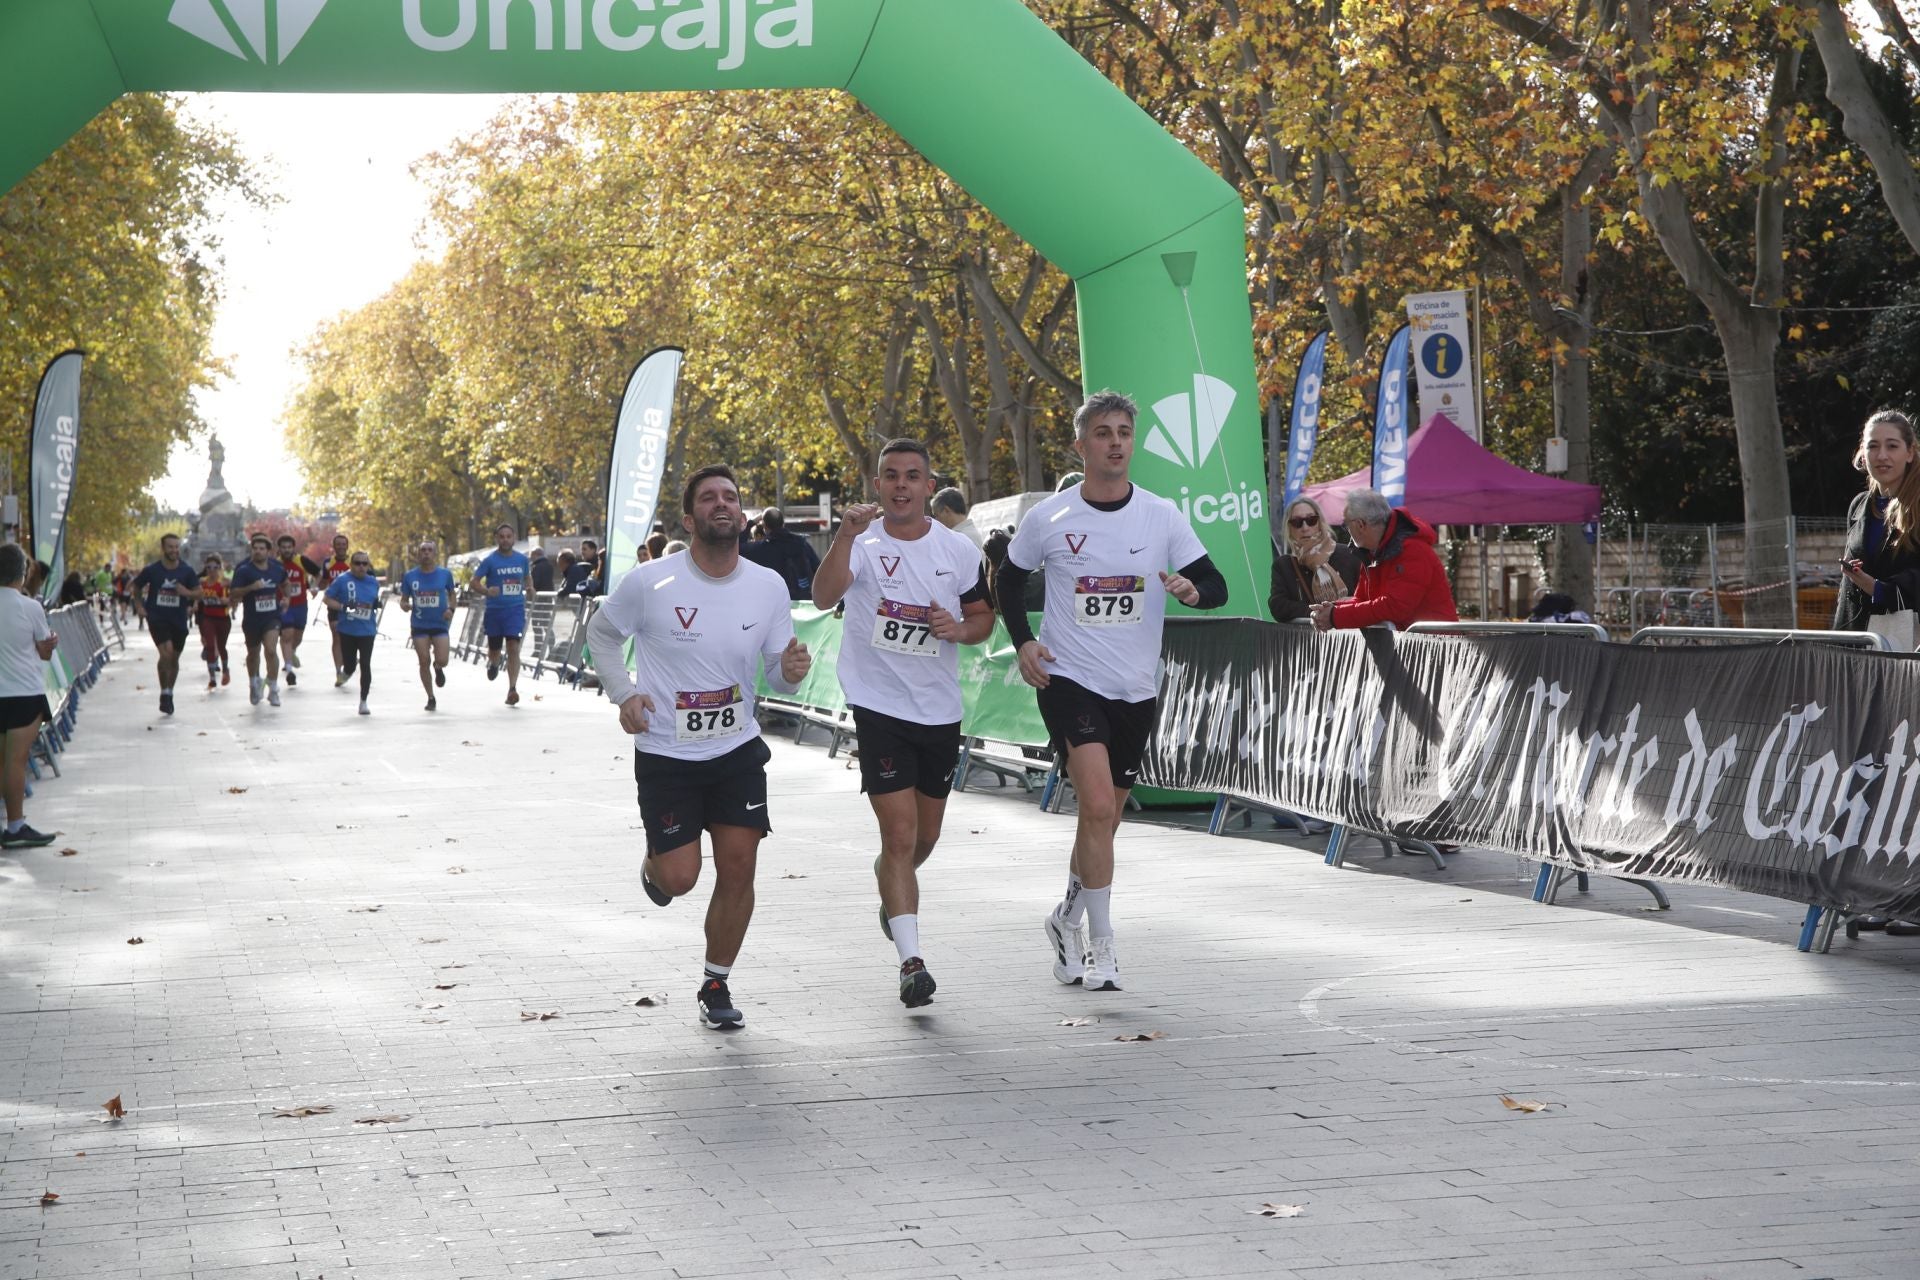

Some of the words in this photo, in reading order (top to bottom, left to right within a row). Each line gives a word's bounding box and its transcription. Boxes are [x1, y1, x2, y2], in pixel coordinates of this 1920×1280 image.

[402, 0, 814, 71] Unicaja
[1414, 302, 1440, 311] Oficina
[1380, 369, 1406, 497] IVECO
[623, 407, 669, 525] Unicaja
[1165, 481, 1263, 531] icaja
[497, 566, 523, 575] IVECO
[420, 596, 437, 604] 580
[1085, 595, 1134, 617] 879
[670, 629, 687, 638] Saint
[687, 630, 704, 639] Jean
[883, 620, 931, 646] 877
[686, 707, 736, 732] 878
[1663, 707, 1738, 834] de
